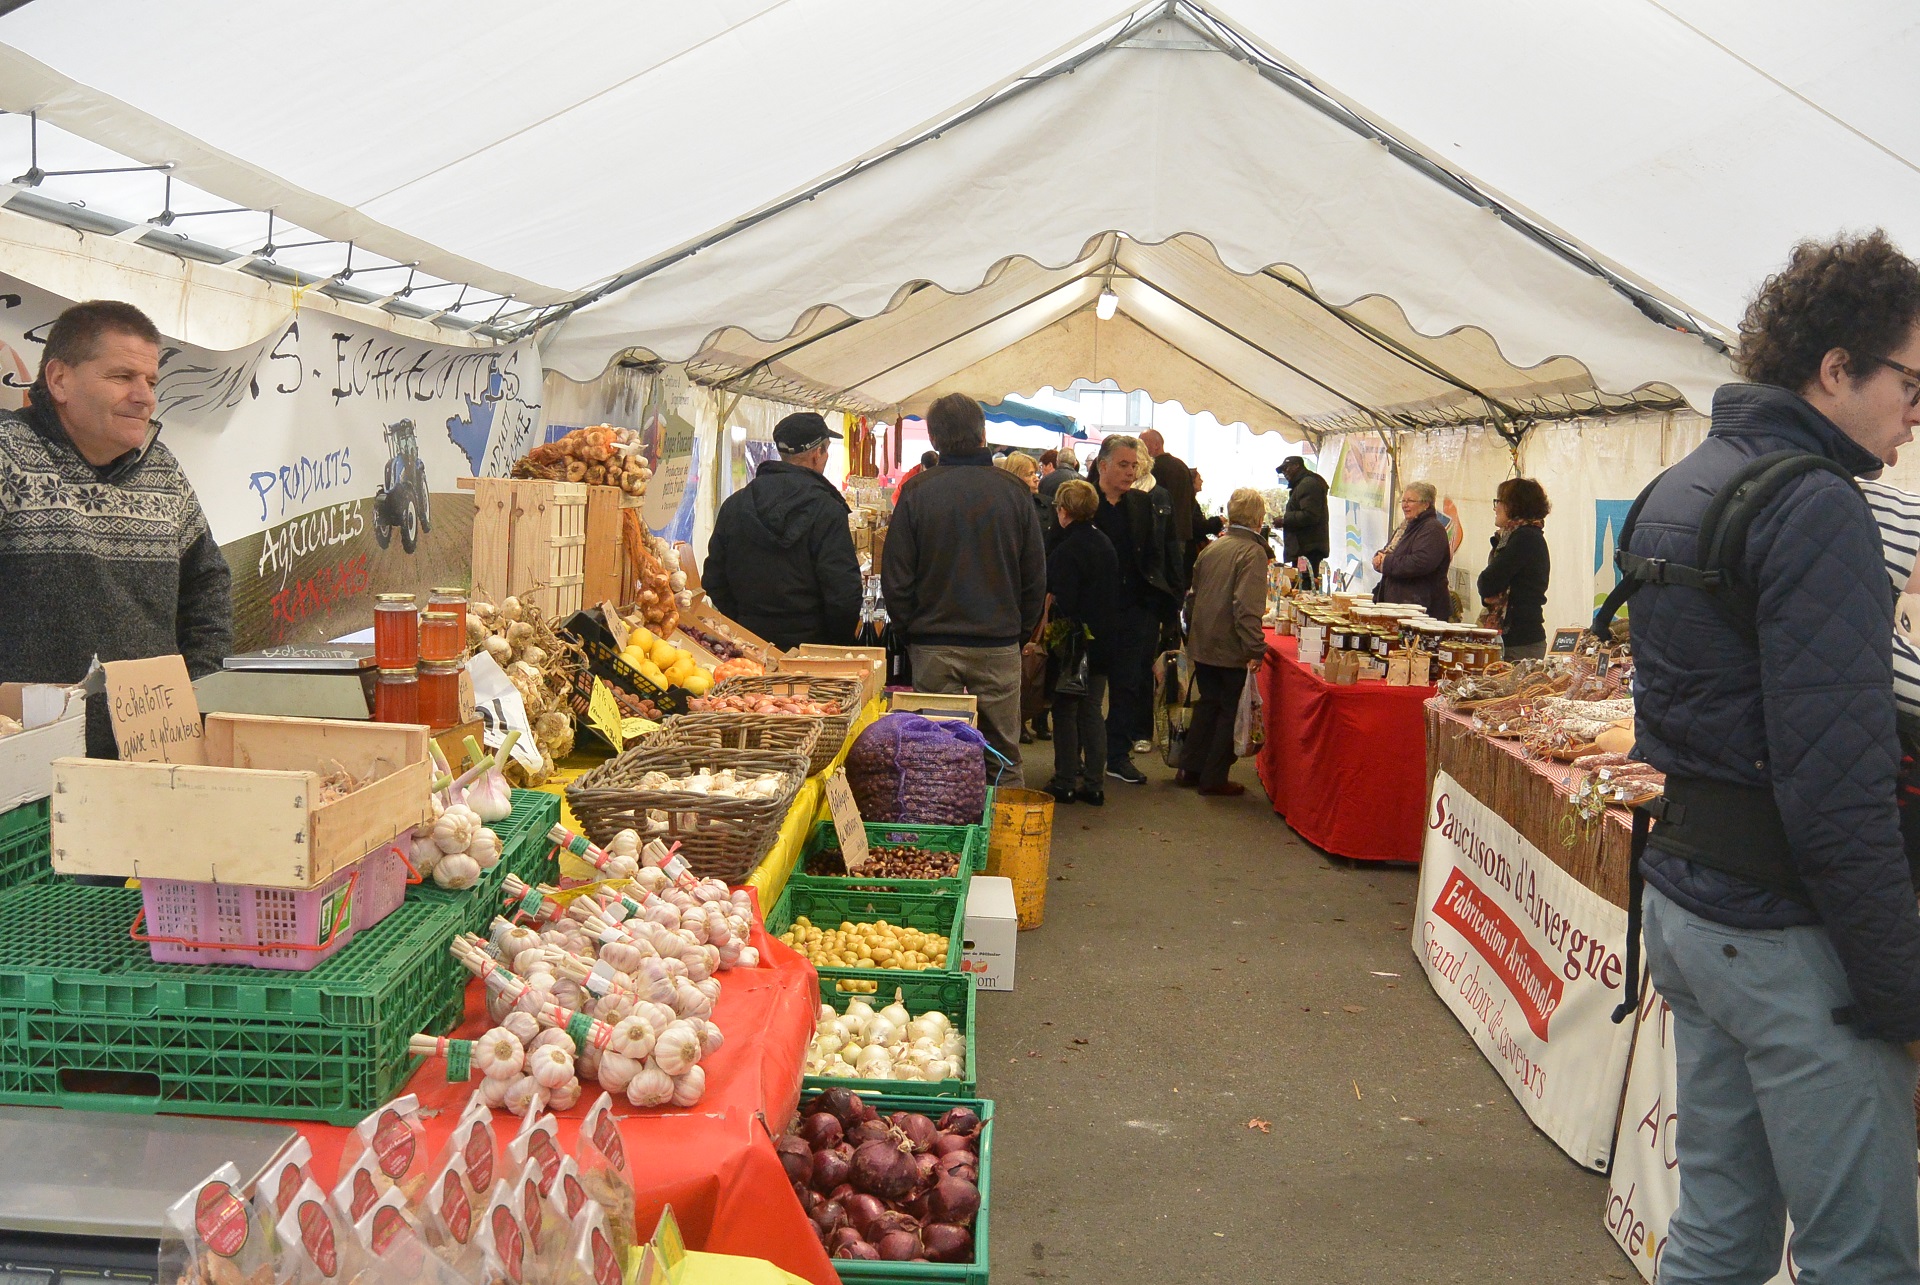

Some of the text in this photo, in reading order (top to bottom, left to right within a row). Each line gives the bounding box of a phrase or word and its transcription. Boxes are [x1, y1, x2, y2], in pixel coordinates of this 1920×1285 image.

[249, 446, 352, 522] PRODUITS
[258, 499, 365, 592] AGRICOLES
[1428, 792, 1513, 894] Saucissons
[1443, 878, 1557, 1021] Fabrication Artisanale
[1513, 861, 1623, 991] d'Auvergne
[976, 975, 999, 988] om'
[1422, 919, 1547, 1101] Grand choix de saveurs
[1604, 1182, 1645, 1257] che
